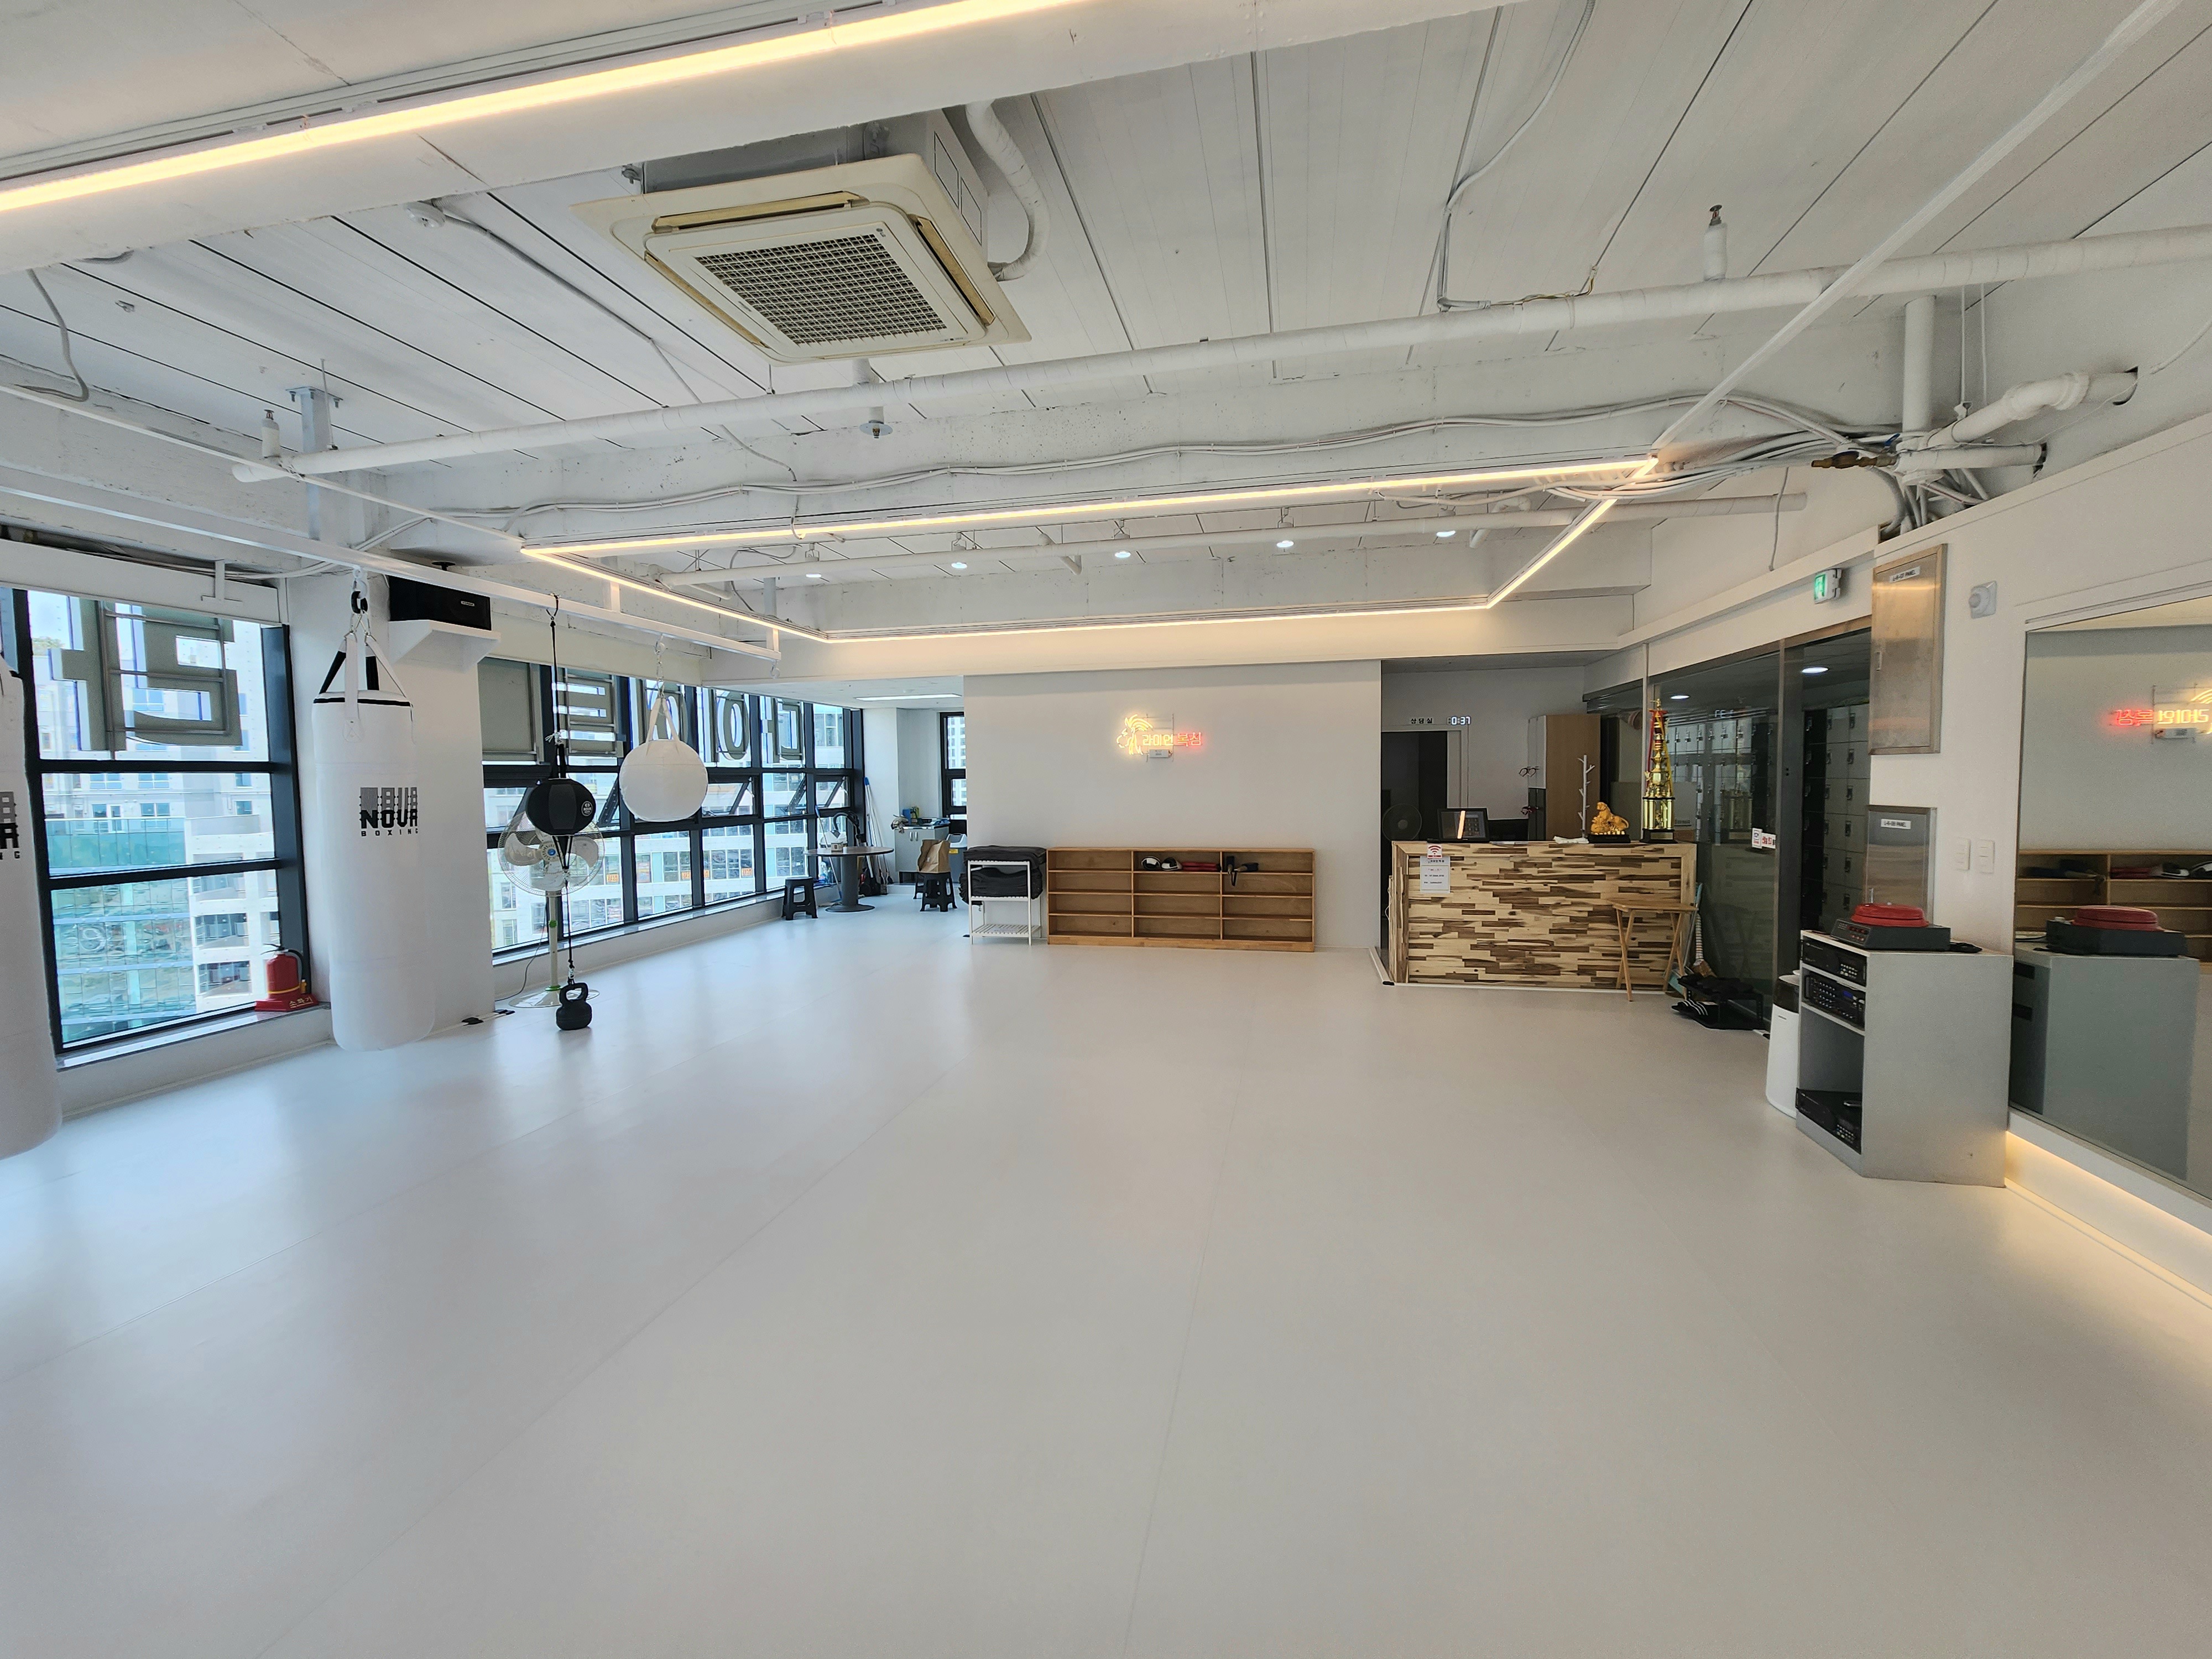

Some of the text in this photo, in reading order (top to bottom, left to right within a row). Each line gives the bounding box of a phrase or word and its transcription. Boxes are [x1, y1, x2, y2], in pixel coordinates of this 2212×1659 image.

[1142, 734, 1173, 746] 라이언
[361, 828, 419, 837] BOXING
[289, 997, 314, 1007] 소화기
